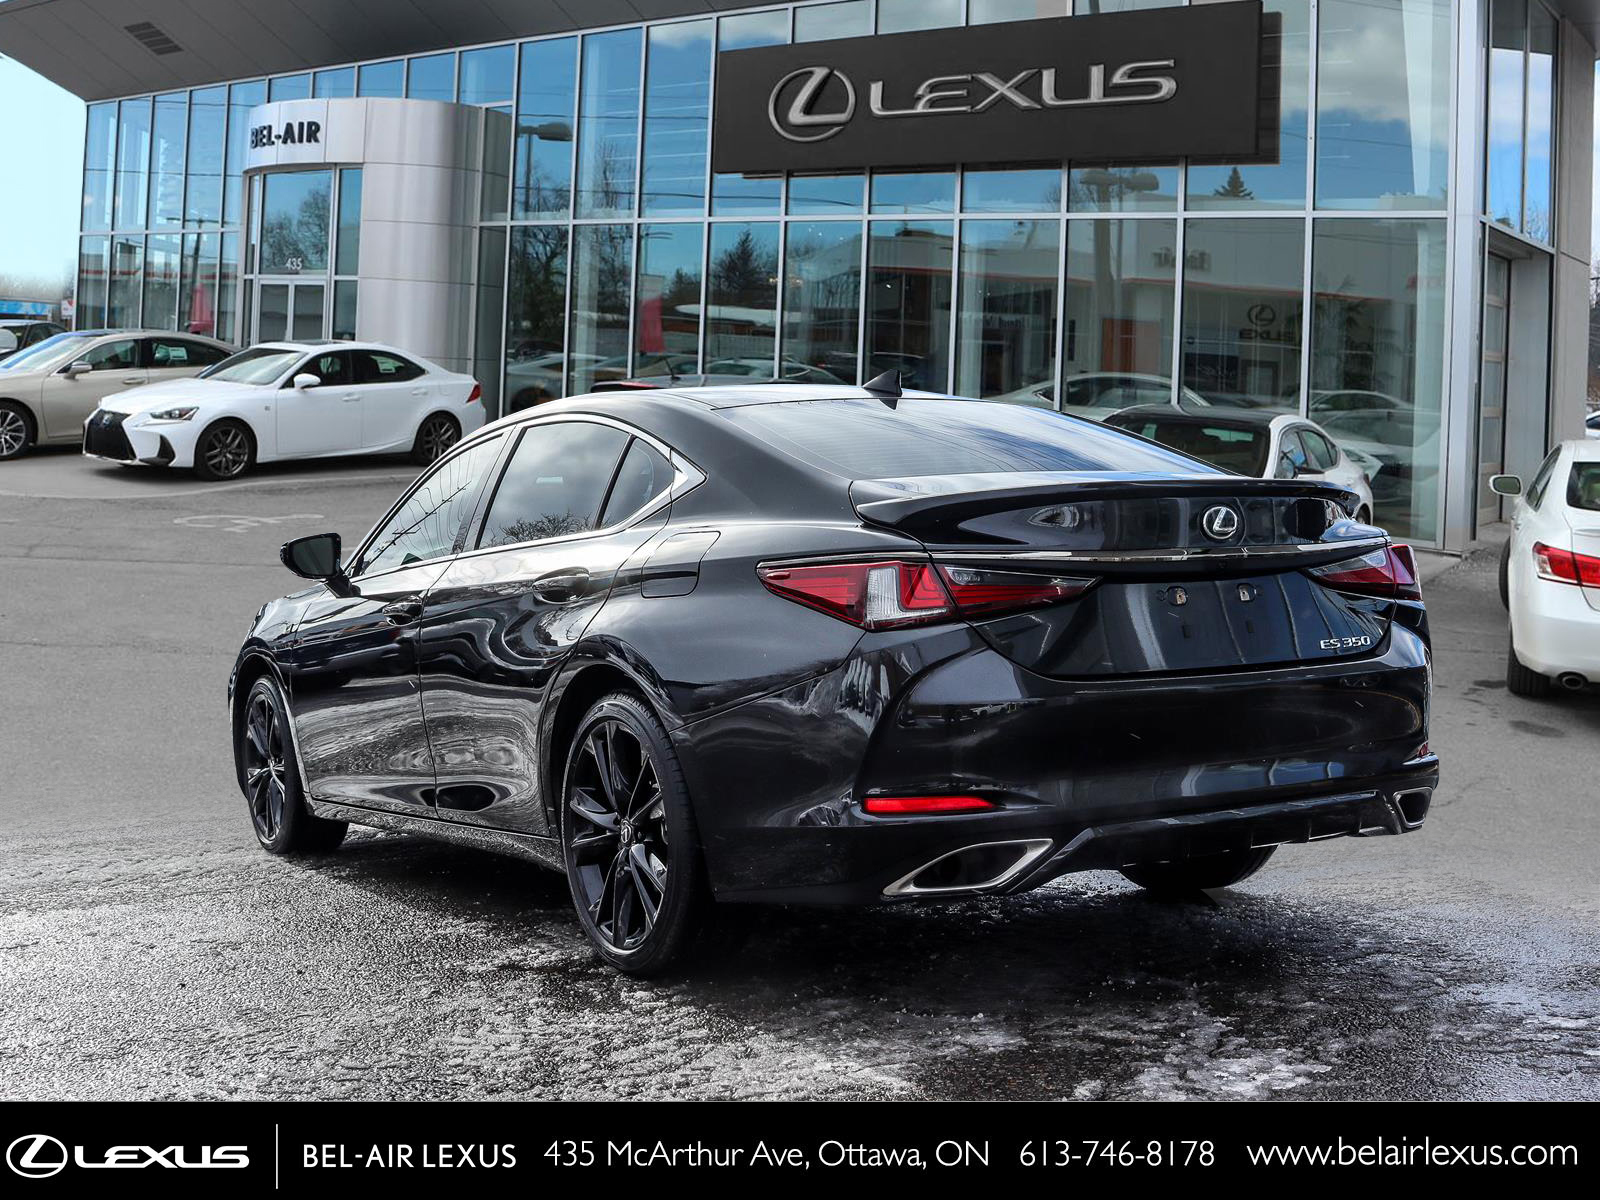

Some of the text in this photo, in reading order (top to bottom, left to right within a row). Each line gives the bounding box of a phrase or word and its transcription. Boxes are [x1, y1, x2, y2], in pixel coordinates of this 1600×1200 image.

[869, 58, 1177, 118] LEXUS
[250, 120, 321, 149] BEL-AIR
[285, 257, 303, 271] 435
[1320, 635, 1371, 650] ES 350
